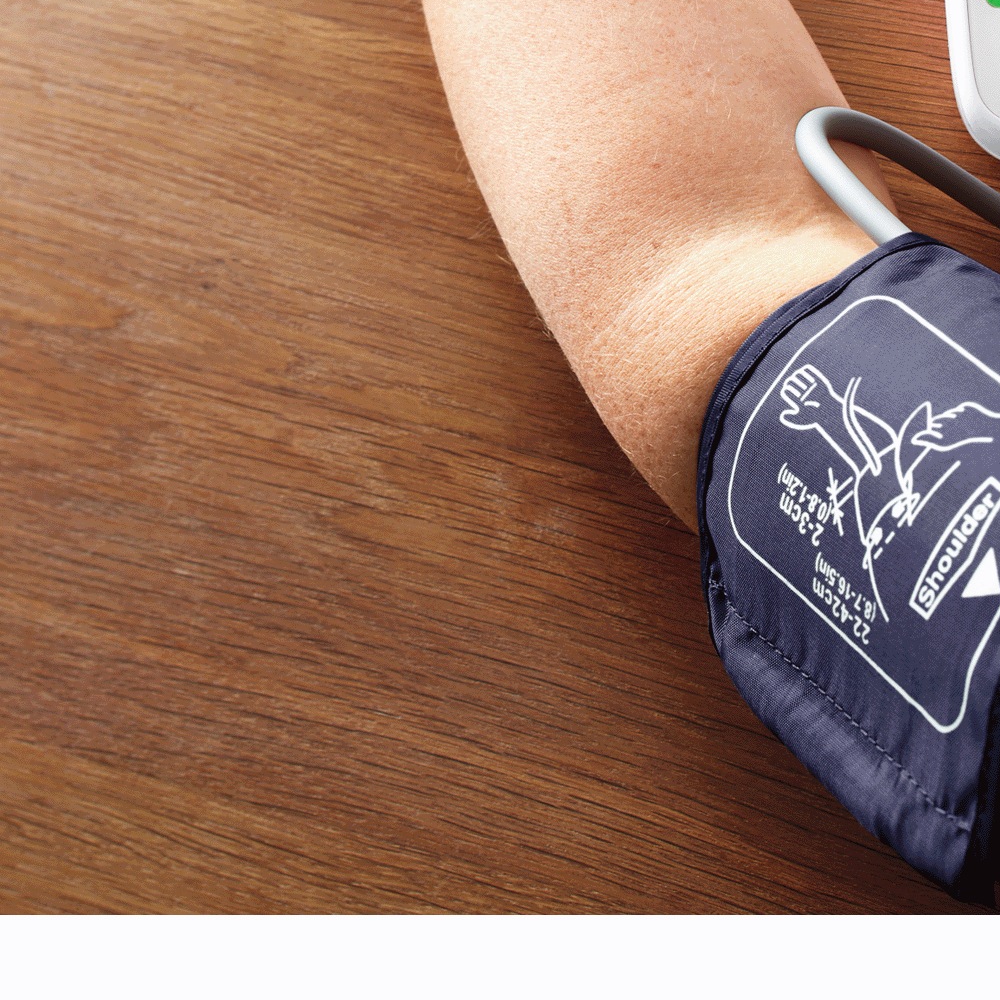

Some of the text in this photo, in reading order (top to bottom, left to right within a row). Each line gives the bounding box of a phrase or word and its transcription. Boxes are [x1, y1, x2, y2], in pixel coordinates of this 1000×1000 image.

[780, 492, 825, 547] 2-3cm
[918, 492, 996, 609] Shoulder
[812, 577, 871, 645] 22-42cm
